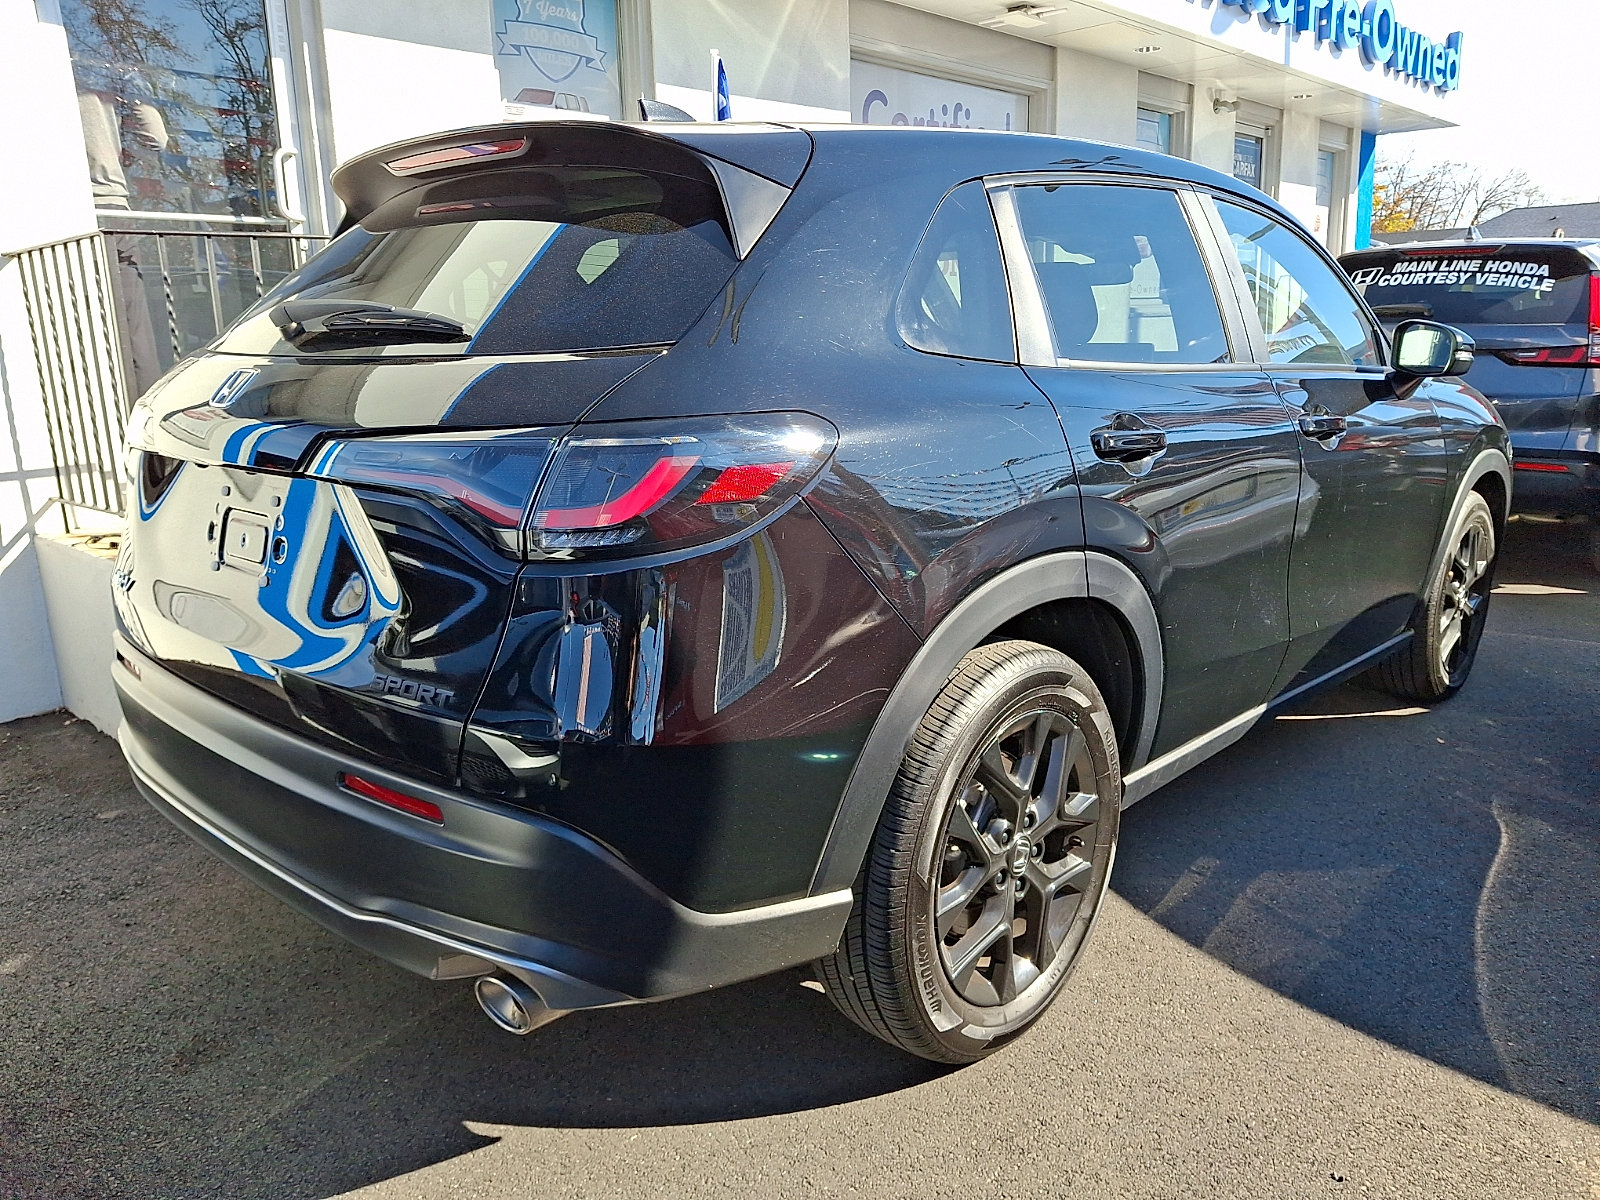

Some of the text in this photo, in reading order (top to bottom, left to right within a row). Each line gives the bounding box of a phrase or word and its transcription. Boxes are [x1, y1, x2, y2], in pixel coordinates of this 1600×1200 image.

[535, 0, 579, 21] Years
[1392, 260, 1549, 277] MAIN LINE HONDA
[1378, 272, 1555, 291] COURTESY VEHICLE
[370, 672, 455, 708] SPORT
